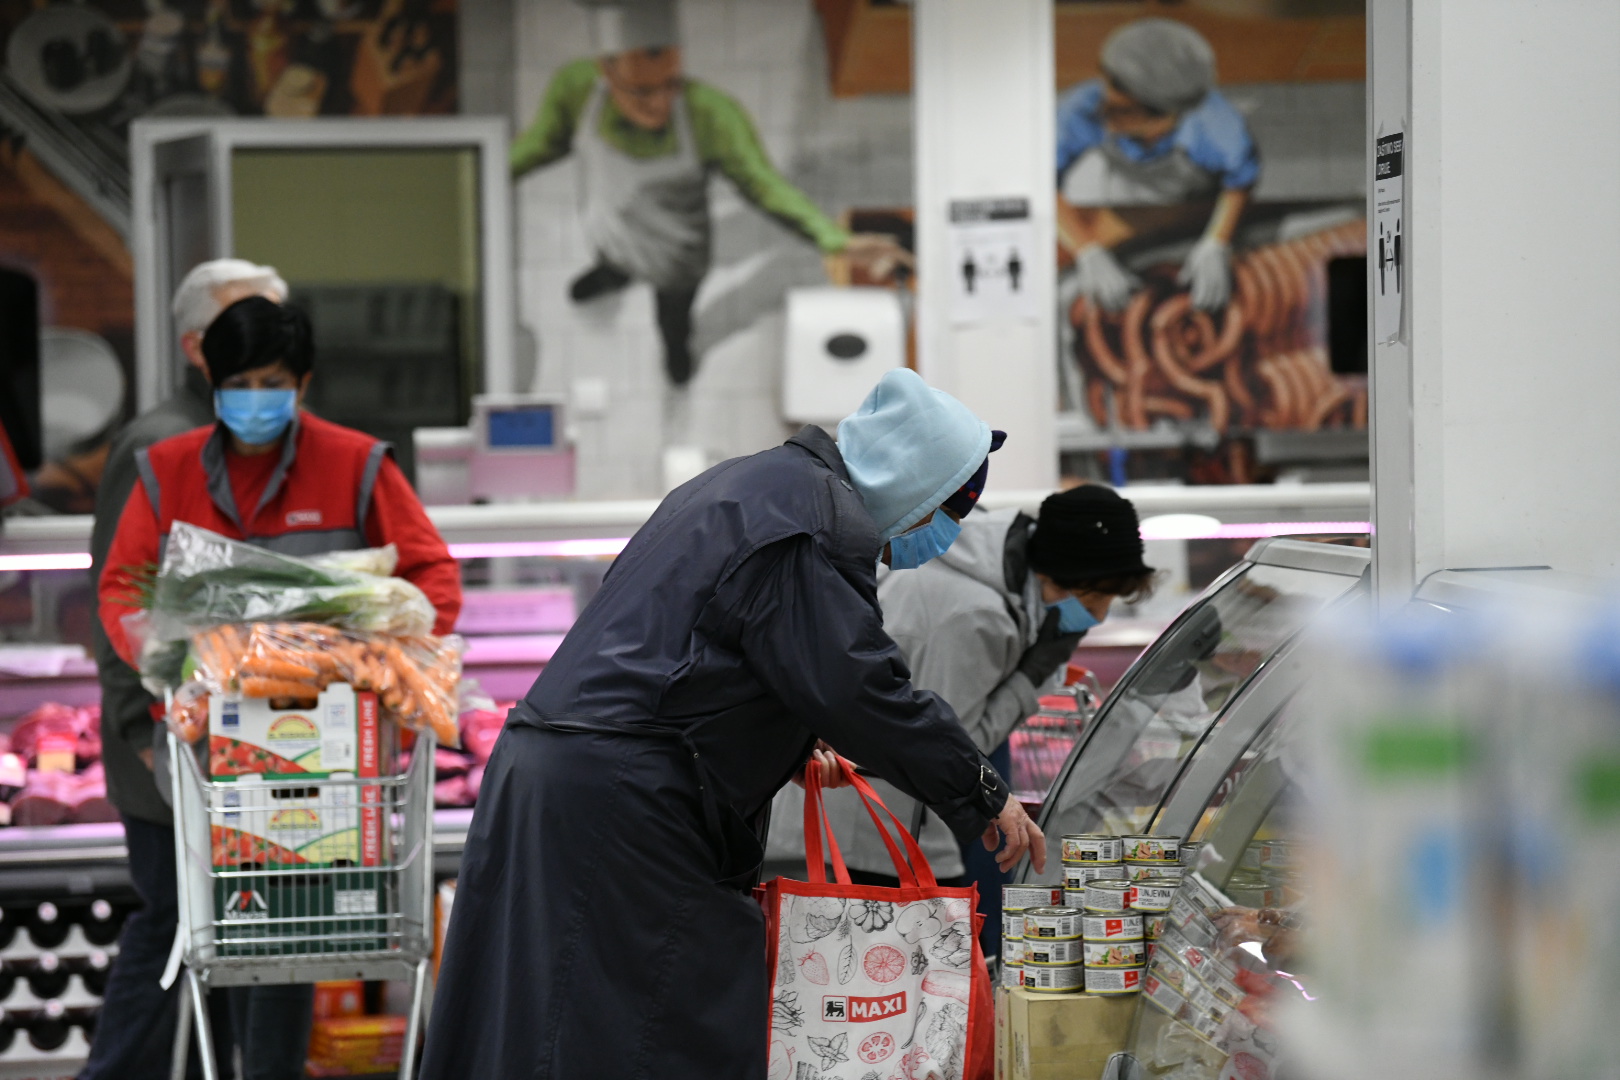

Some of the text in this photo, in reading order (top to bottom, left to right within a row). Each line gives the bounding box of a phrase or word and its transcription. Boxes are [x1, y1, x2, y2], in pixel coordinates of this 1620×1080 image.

[363, 699, 373, 768] FRESH LINE
[1138, 888, 1171, 898] TUNJEVINA
[851, 997, 902, 1018] MAXI
